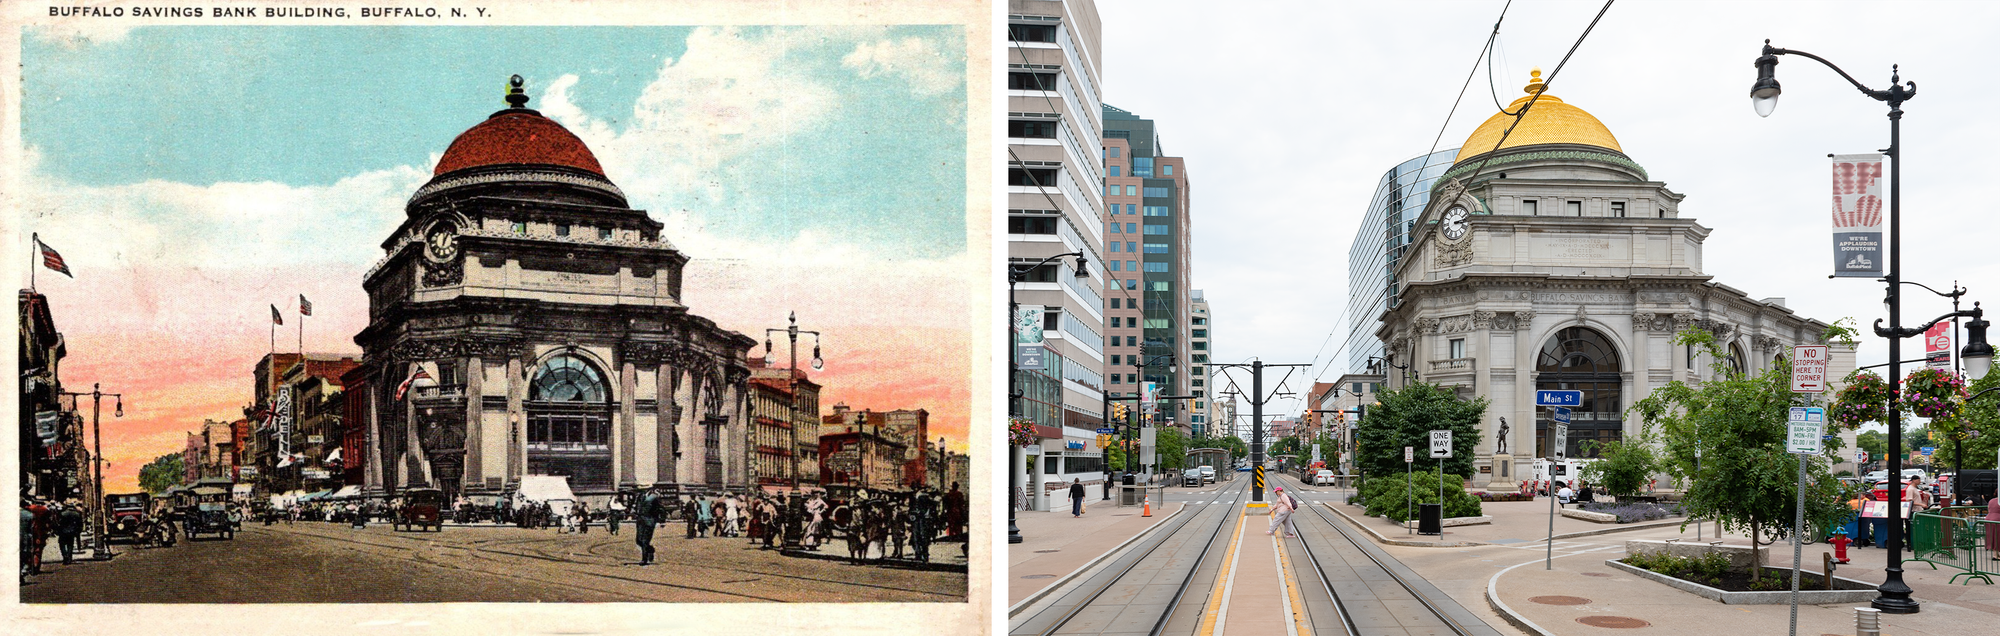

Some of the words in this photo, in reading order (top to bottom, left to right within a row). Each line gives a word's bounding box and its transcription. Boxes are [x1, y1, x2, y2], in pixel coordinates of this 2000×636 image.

[1443, 294, 1467, 305] BANK
[1531, 293, 1566, 302] BUFFALO
[1570, 293, 1604, 302] SAVINGS
[1609, 293, 1631, 302] BANK
[1804, 349, 1817, 358] NO
[1543, 393, 1562, 403] Main
[1565, 394, 1573, 402] St
[1433, 432, 1449, 440] ONE
